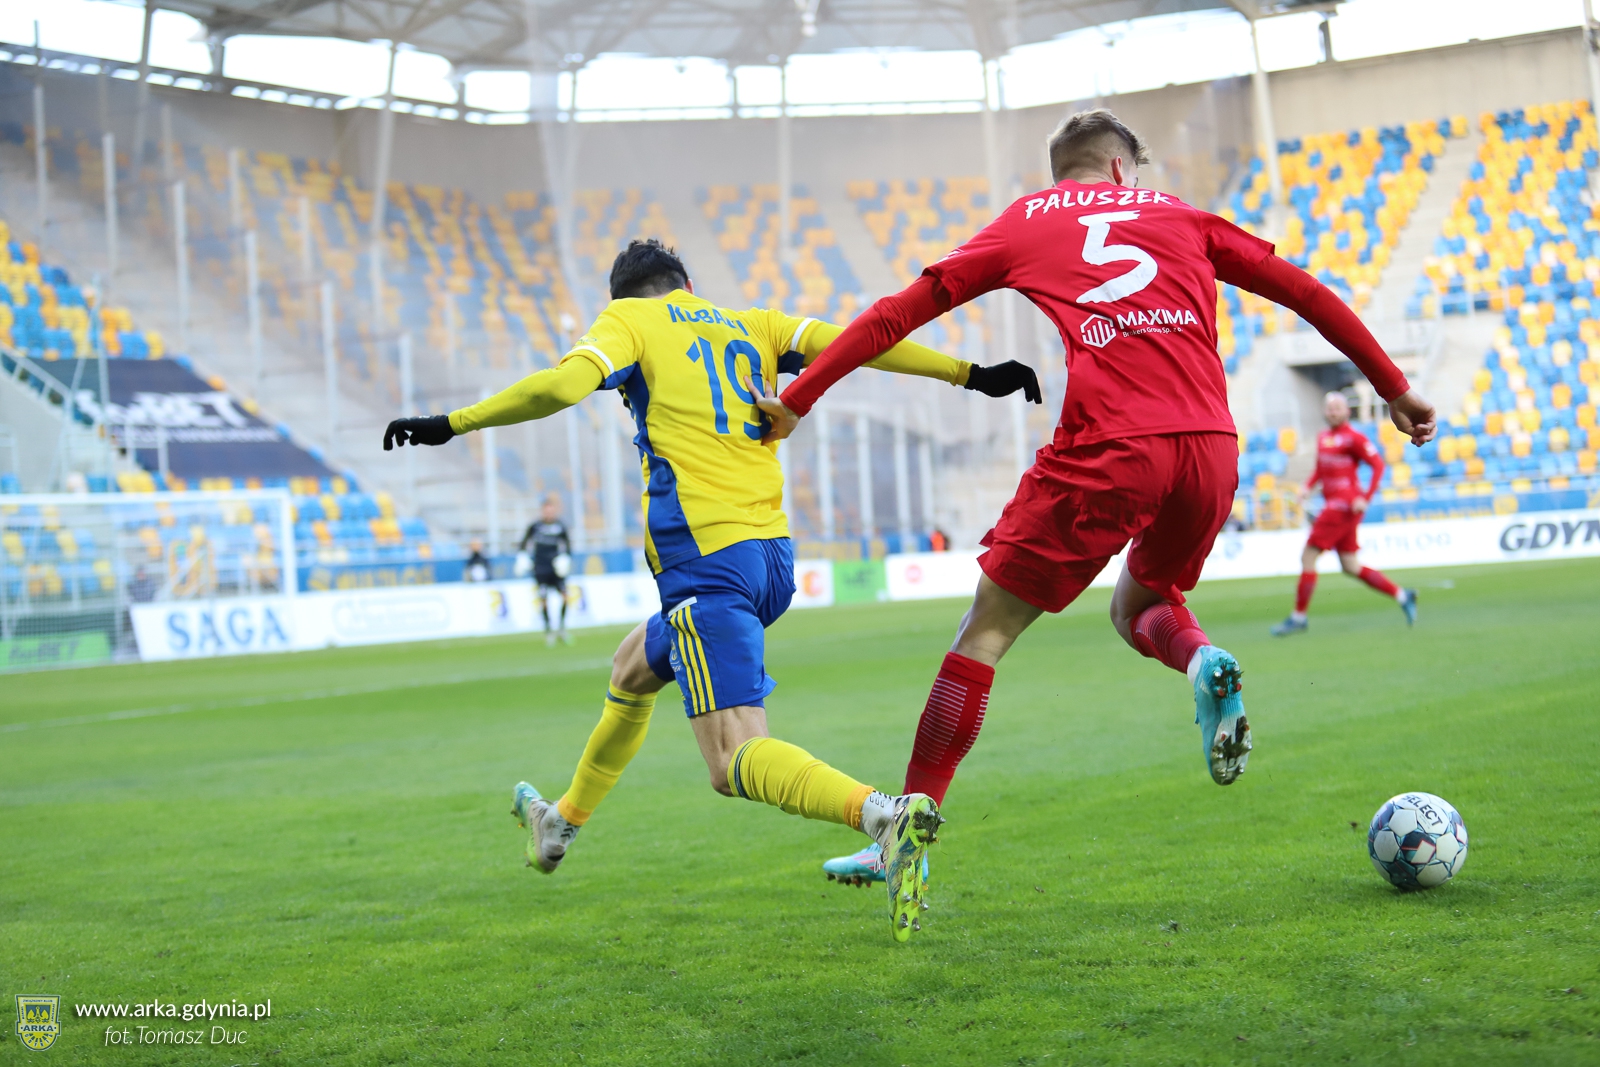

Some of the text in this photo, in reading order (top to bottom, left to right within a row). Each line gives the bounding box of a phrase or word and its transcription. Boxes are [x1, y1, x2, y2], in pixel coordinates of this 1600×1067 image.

[1025, 190, 1173, 220] PALUSZEK
[1076, 210, 1158, 304] 5
[1116, 308, 1198, 330] MAXIMA
[1122, 327, 1147, 338] Brokers
[685, 335, 772, 441] 19
[166, 605, 288, 652] SAGA
[1401, 794, 1444, 827] SELECT
